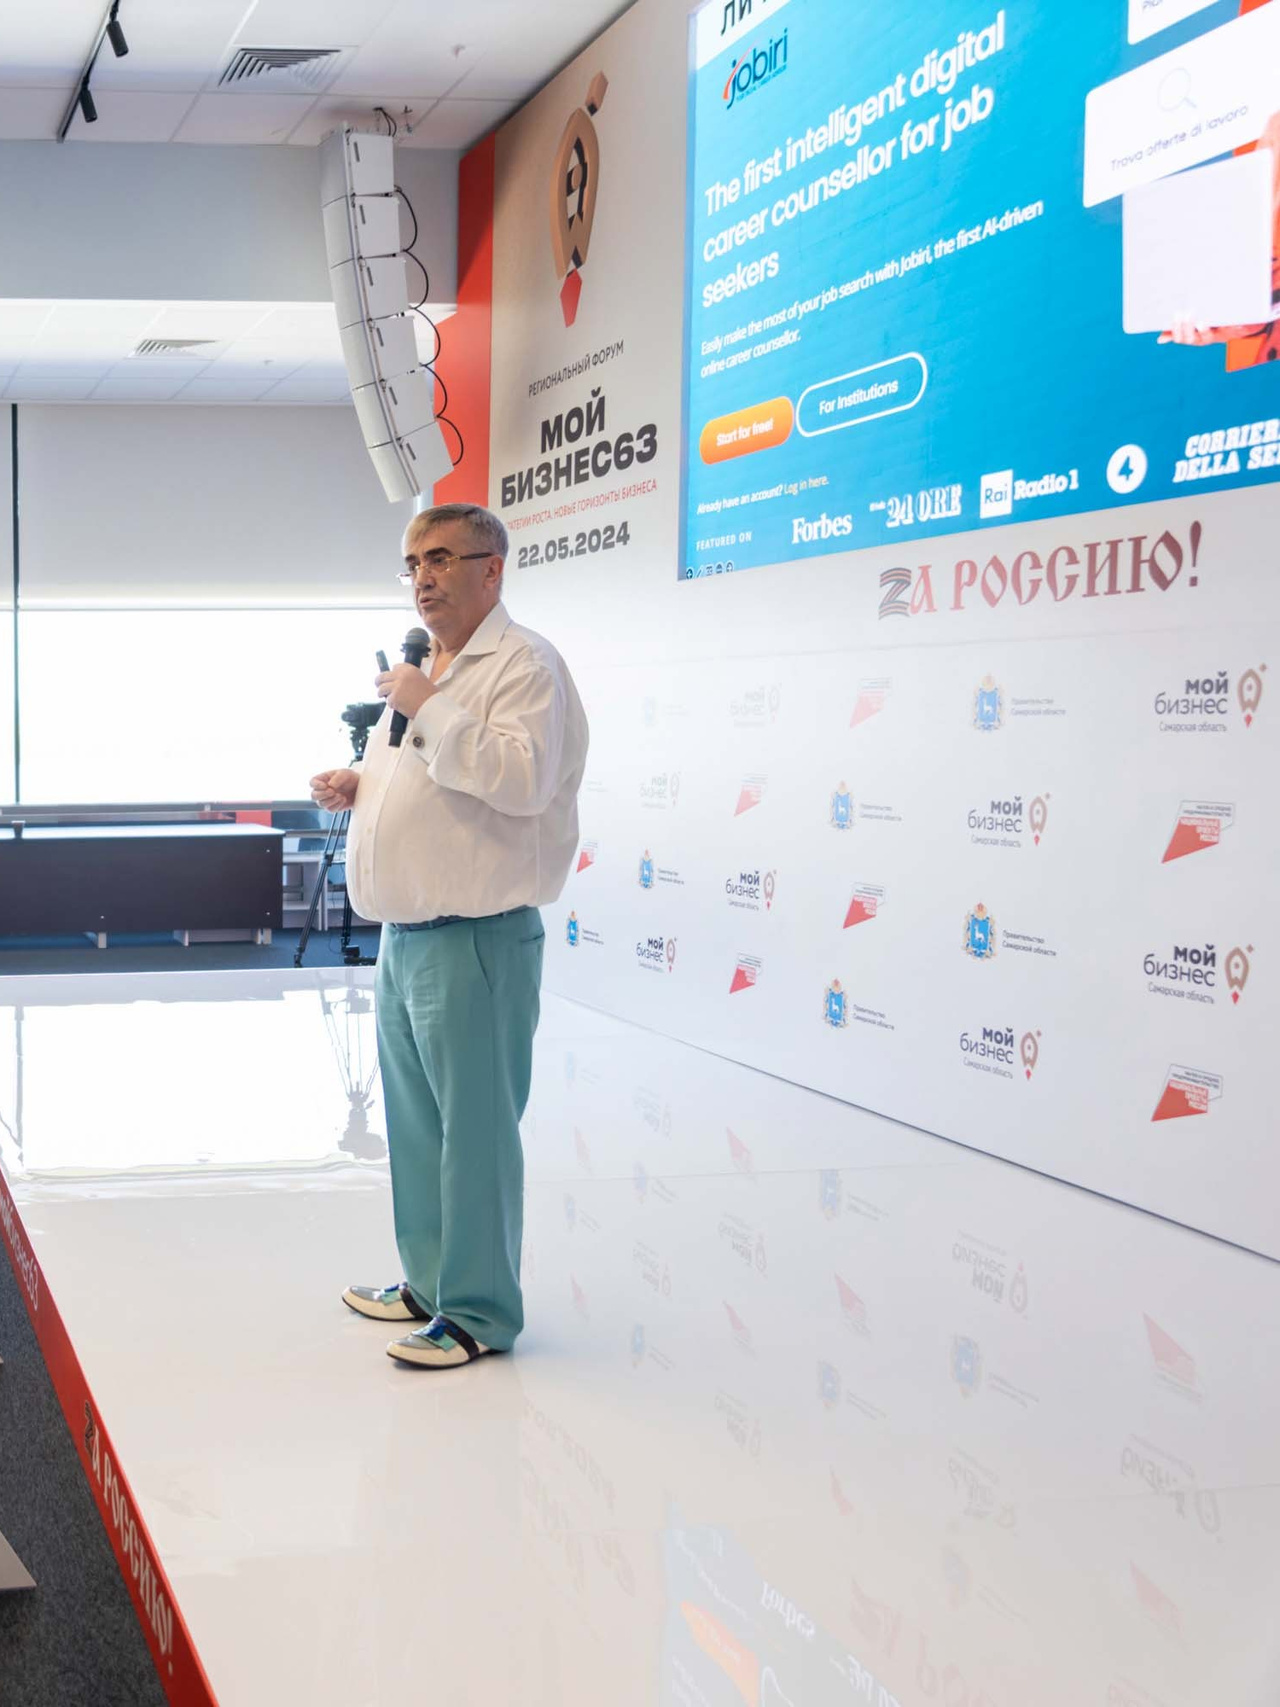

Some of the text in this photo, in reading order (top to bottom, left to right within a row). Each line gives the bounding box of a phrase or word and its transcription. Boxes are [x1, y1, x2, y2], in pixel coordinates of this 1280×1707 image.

[722, 28, 788, 110] jobiri
[705, 175, 740, 216] The
[744, 148, 782, 195] first
[785, 73, 906, 171] intelligent
[910, 10, 1005, 95] digital
[1111, 105, 1249, 171] Trova offerte di lavoro
[703, 84, 994, 262] career counsellor for job
[701, 200, 1044, 356] Easily make the most of your job search with Jobiri, the first AI-driven
[702, 251, 779, 308] seekers
[528, 340, 624, 397] РЕГИОНАЛЬНЫЙ ФОРУМ
[701, 328, 802, 378] online career counsellor.
[819, 380, 899, 415] For Institutions
[540, 386, 606, 454] МОЙ
[716, 418, 774, 447] Start for free!
[1185, 418, 1280, 458] CORRIER
[501, 423, 658, 508] БИЗНЕС63
[1172, 450, 1241, 484] DELLA
[553, 502, 577, 517] НОВЫЕ
[577, 490, 620, 513] ГОРИЗОНТЫ
[621, 478, 658, 500] БИЗНЕСА
[696, 475, 830, 515] Already have an account? Log in here.
[886, 483, 963, 528] 24 ORE
[984, 484, 1009, 504] Rai
[1013, 472, 1068, 501] Radio
[518, 521, 630, 569] 22.05.2024
[696, 530, 752, 551] FEATURED ON
[791, 512, 853, 544] Forbes
[950, 520, 1202, 611] РОССИЮ!
[1185, 671, 1228, 695] мой
[1154, 691, 1228, 715] бизнес
[968, 809, 1022, 833] бизнес
[990, 796, 1023, 816] мой
[726, 879, 760, 899] бизнес
[740, 870, 760, 886] мой
[636, 943, 663, 963] бизнес
[648, 937, 663, 951] мой
[1173, 943, 1216, 968] мой
[1143, 953, 1215, 987] бизнес
[960, 1032, 1014, 1064] бизнес
[982, 1026, 1014, 1048] мой
[103, 1451, 175, 1676] РОССИЮ!
